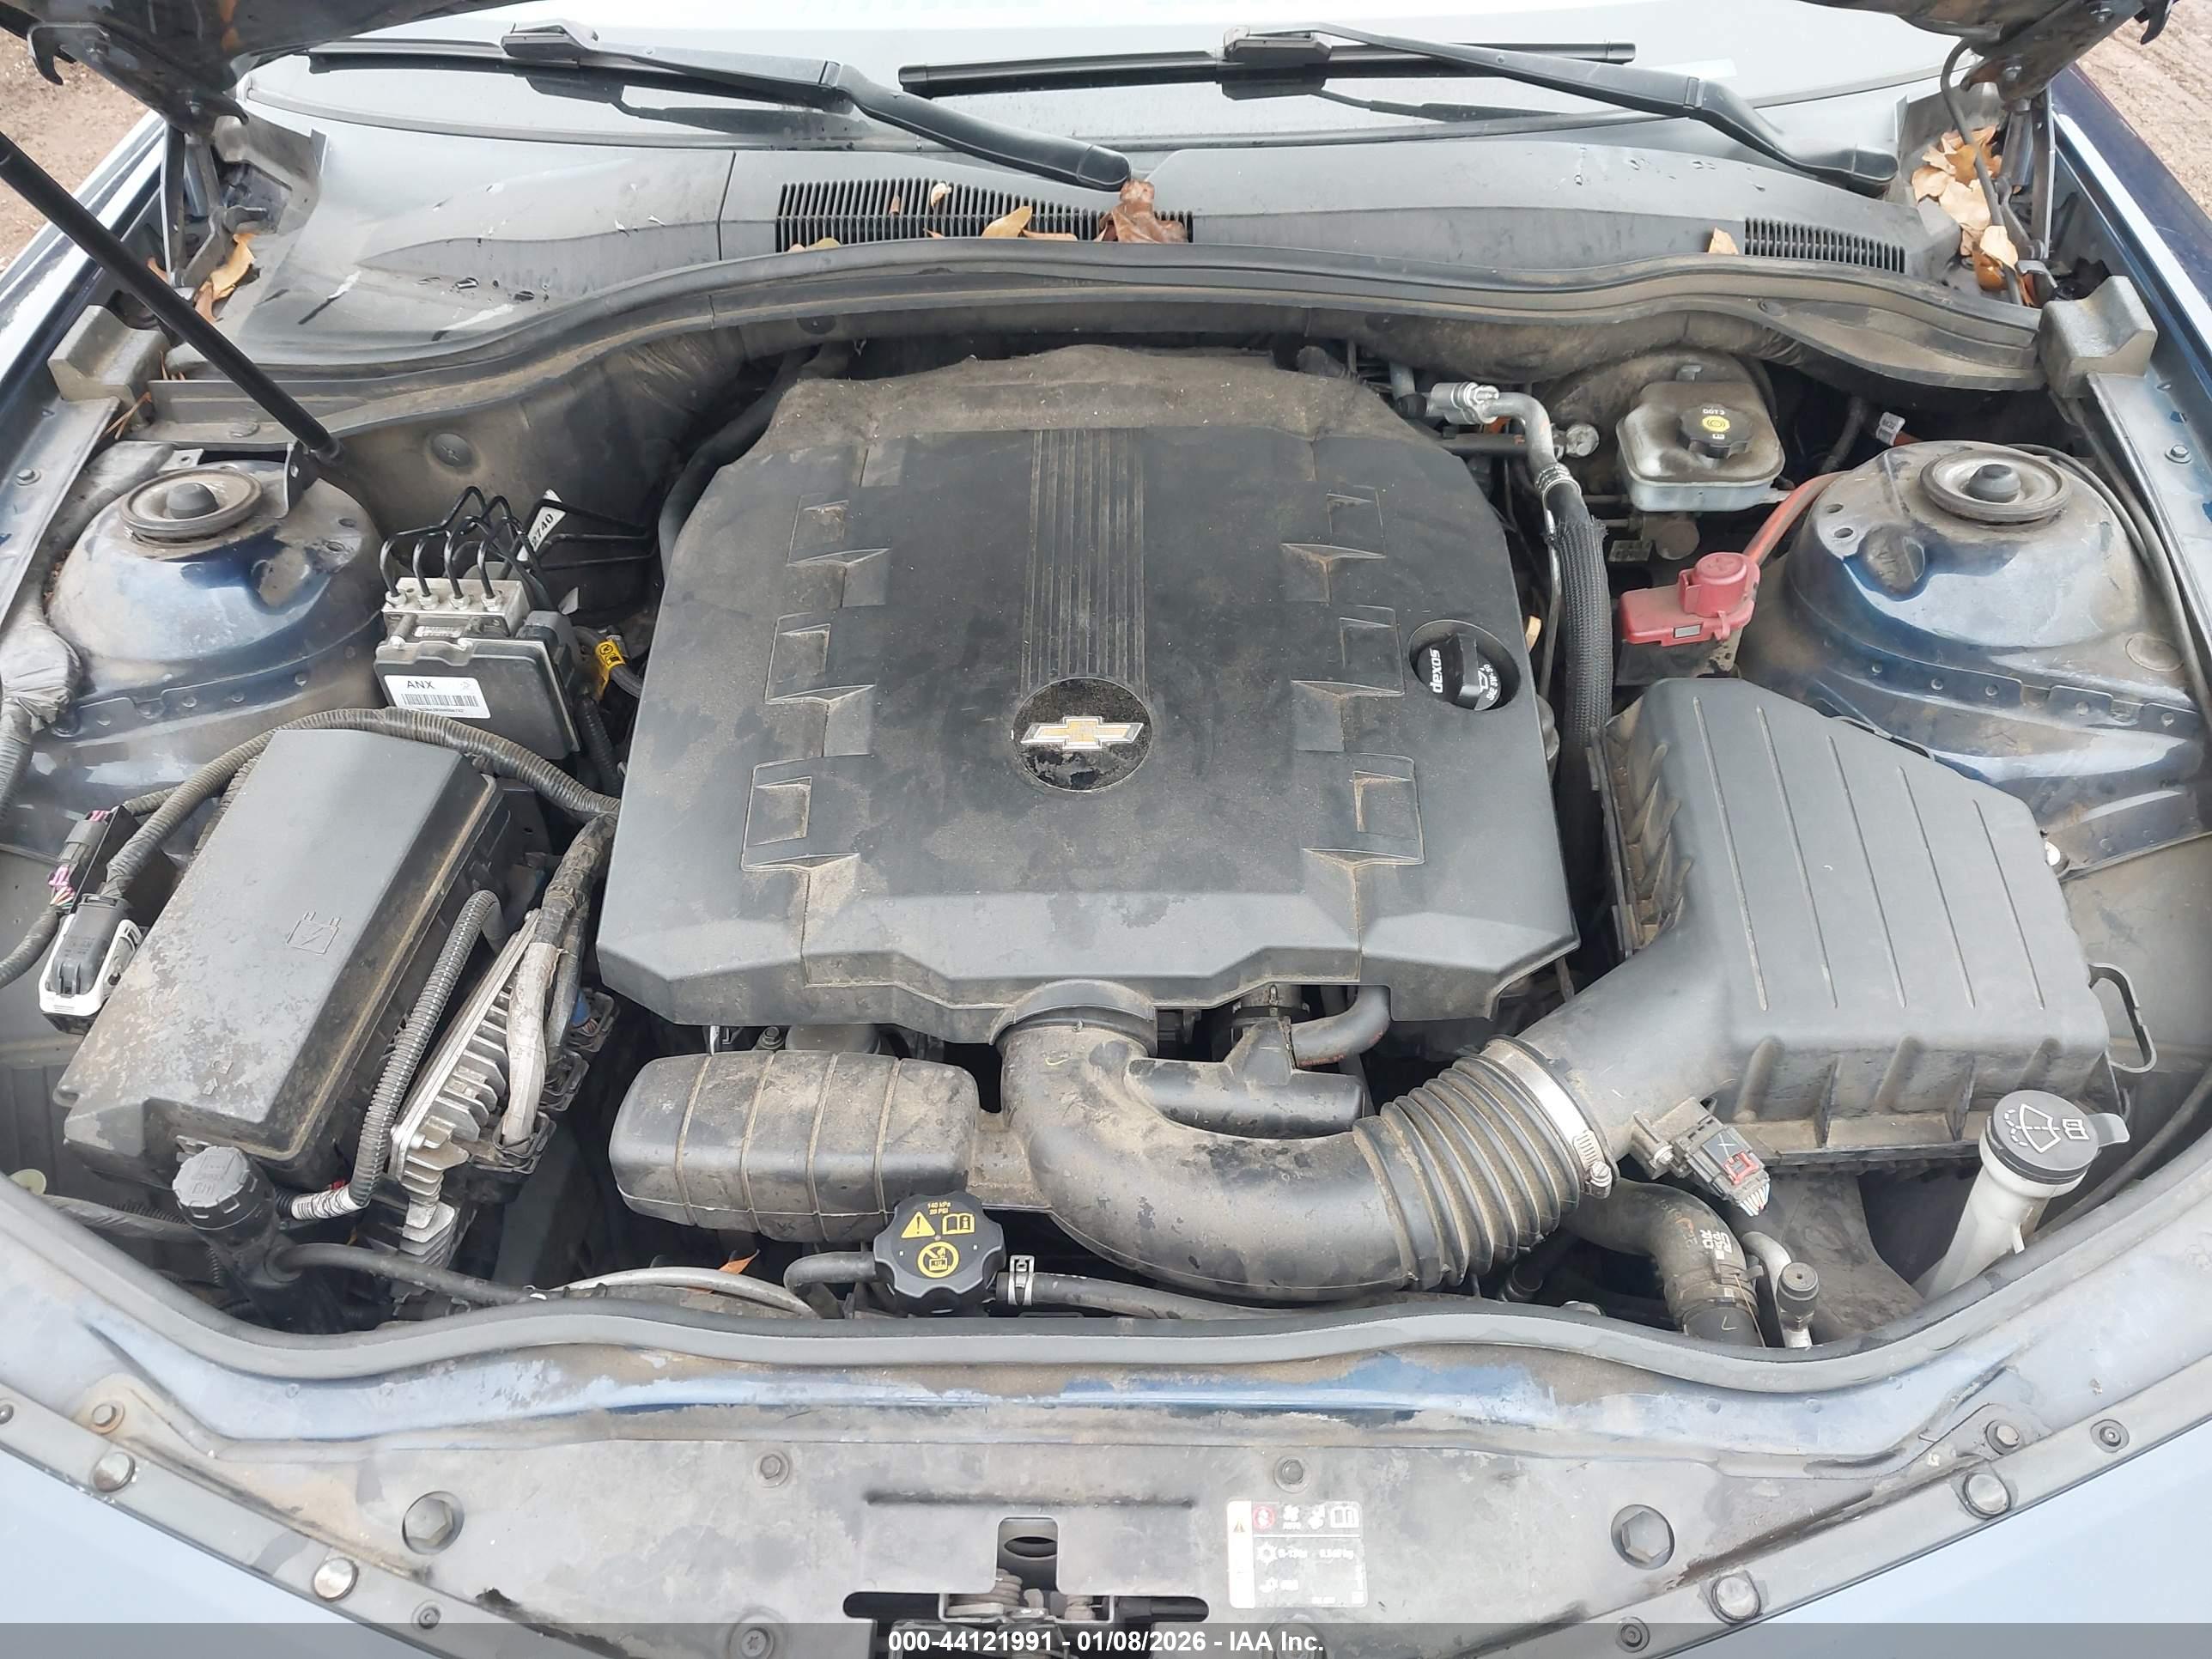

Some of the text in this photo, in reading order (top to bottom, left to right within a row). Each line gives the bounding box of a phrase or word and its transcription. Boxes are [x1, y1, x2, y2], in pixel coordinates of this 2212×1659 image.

[532, 513, 554, 548] 2740
[1429, 647, 1443, 694] dexos
[406, 679, 435, 690] ANX
[927, 1202, 939, 1213] 140
